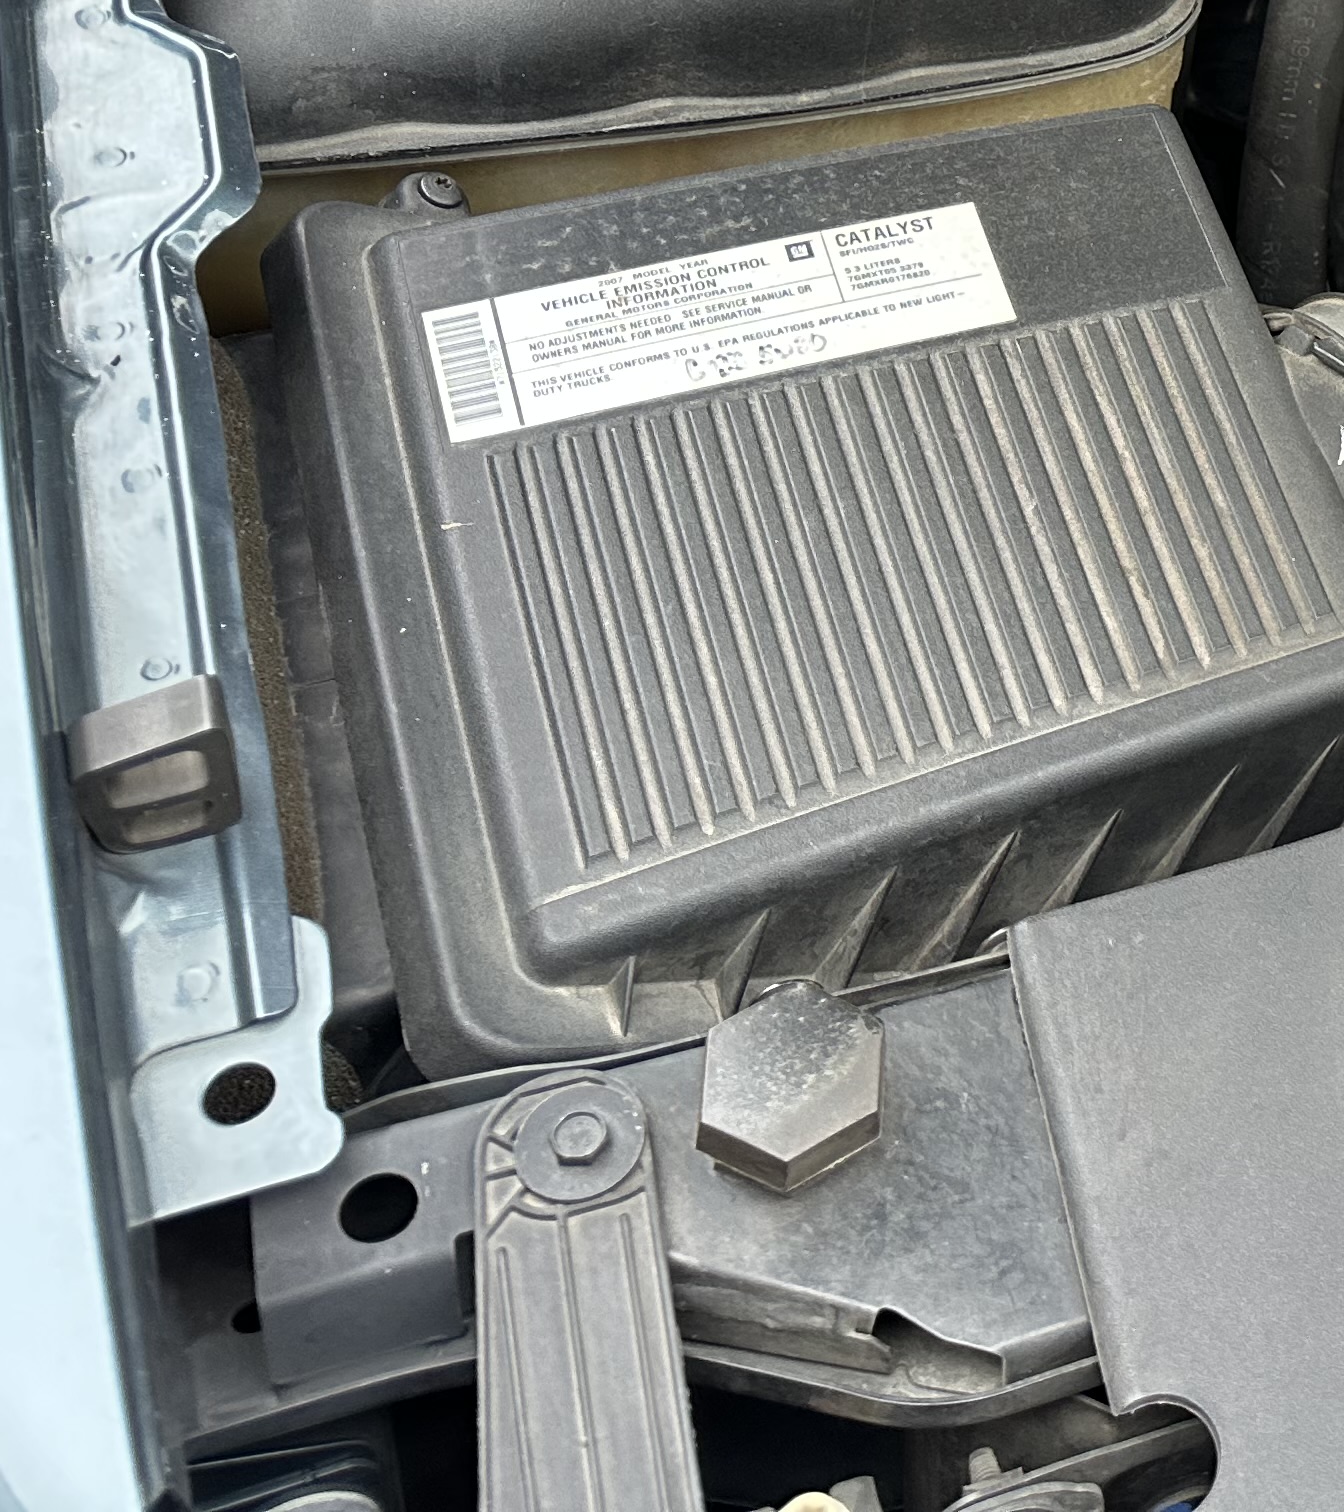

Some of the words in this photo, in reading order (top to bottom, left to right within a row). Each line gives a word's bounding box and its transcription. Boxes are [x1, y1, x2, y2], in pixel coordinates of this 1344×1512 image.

[833, 215, 937, 248] CATALYST
[631, 265, 671, 280] MODEL
[678, 258, 709, 271] YEAR
[863, 256, 902, 271] LITERS
[540, 288, 608, 312] VEHICLE
[612, 271, 692, 297] EMISSION
[695, 256, 771, 280] CONTROL
[604, 277, 718, 310] INFORMATION
[527, 338, 546, 351] NO
[545, 321, 628, 348] ADJUSTMENTS
[628, 312, 673, 331] NEEDED
[680, 306, 702, 320] SEE
[703, 296, 749, 315] SERVICE
[749, 287, 795, 305] MANUAL
[796, 283, 814, 296] OR
[564, 309, 618, 328] GENERAL
[620, 298, 671, 316] MOTORS
[672, 281, 754, 305] CORPORATION
[530, 343, 579, 363] OWNERS
[580, 333, 628, 352] MANUAL
[629, 328, 653, 342] FOR
[654, 321, 687, 337] MORE
[530, 374, 558, 389] THIS
[559, 364, 608, 383] VEHICLE
[608, 350, 671, 373] CONFORMS
[673, 347, 689, 359] TO
[716, 336, 740, 349] EPA
[741, 320, 816, 344] REGULATIONS
[817, 306, 881, 328] APPLICABLE
[881, 303, 898, 314] TO
[898, 297, 924, 311] NEW
[532, 383, 564, 398] DUTY
